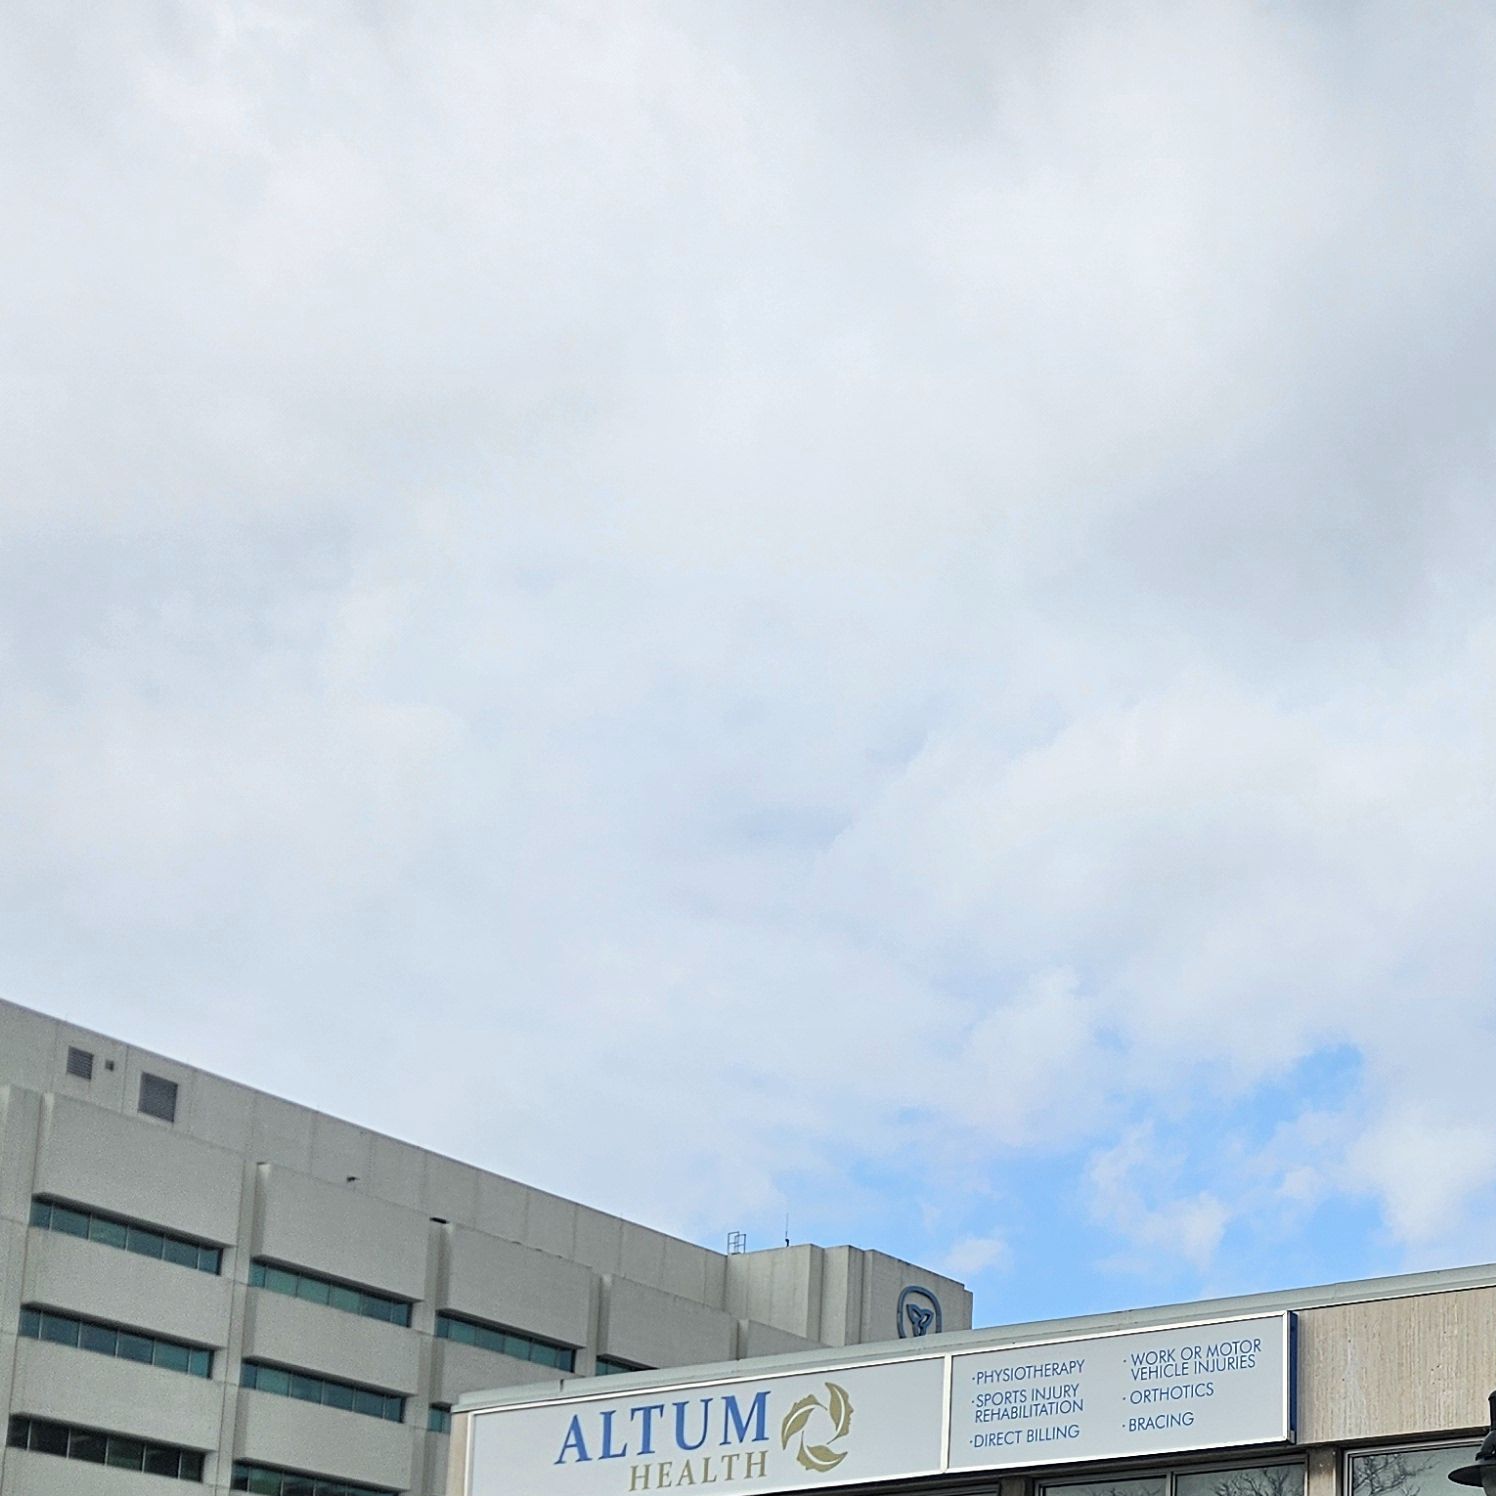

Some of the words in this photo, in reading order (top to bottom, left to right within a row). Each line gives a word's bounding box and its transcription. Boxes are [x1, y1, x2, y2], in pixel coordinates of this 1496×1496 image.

[1131, 1347, 1176, 1366] WORK
[1180, 1346, 1202, 1360] OR
[1206, 1338, 1262, 1358] MOTOR
[976, 1359, 1085, 1385] PHYSIOTHERAPY
[1131, 1361, 1189, 1381] VEHICLE
[1194, 1353, 1256, 1374] INJURIES
[976, 1388, 1027, 1407] SPORTS
[1031, 1383, 1080, 1401] INJURY
[1129, 1382, 1214, 1405] ORTHOTICS
[974, 1399, 1084, 1423] REHABILITATION
[1128, 1411, 1195, 1432] BRACING
[554, 1391, 771, 1464] ALTUM
[973, 1430, 1022, 1448] DIRECT
[1026, 1424, 1080, 1443] BILLING
[628, 1451, 768, 1492] HEALTH
